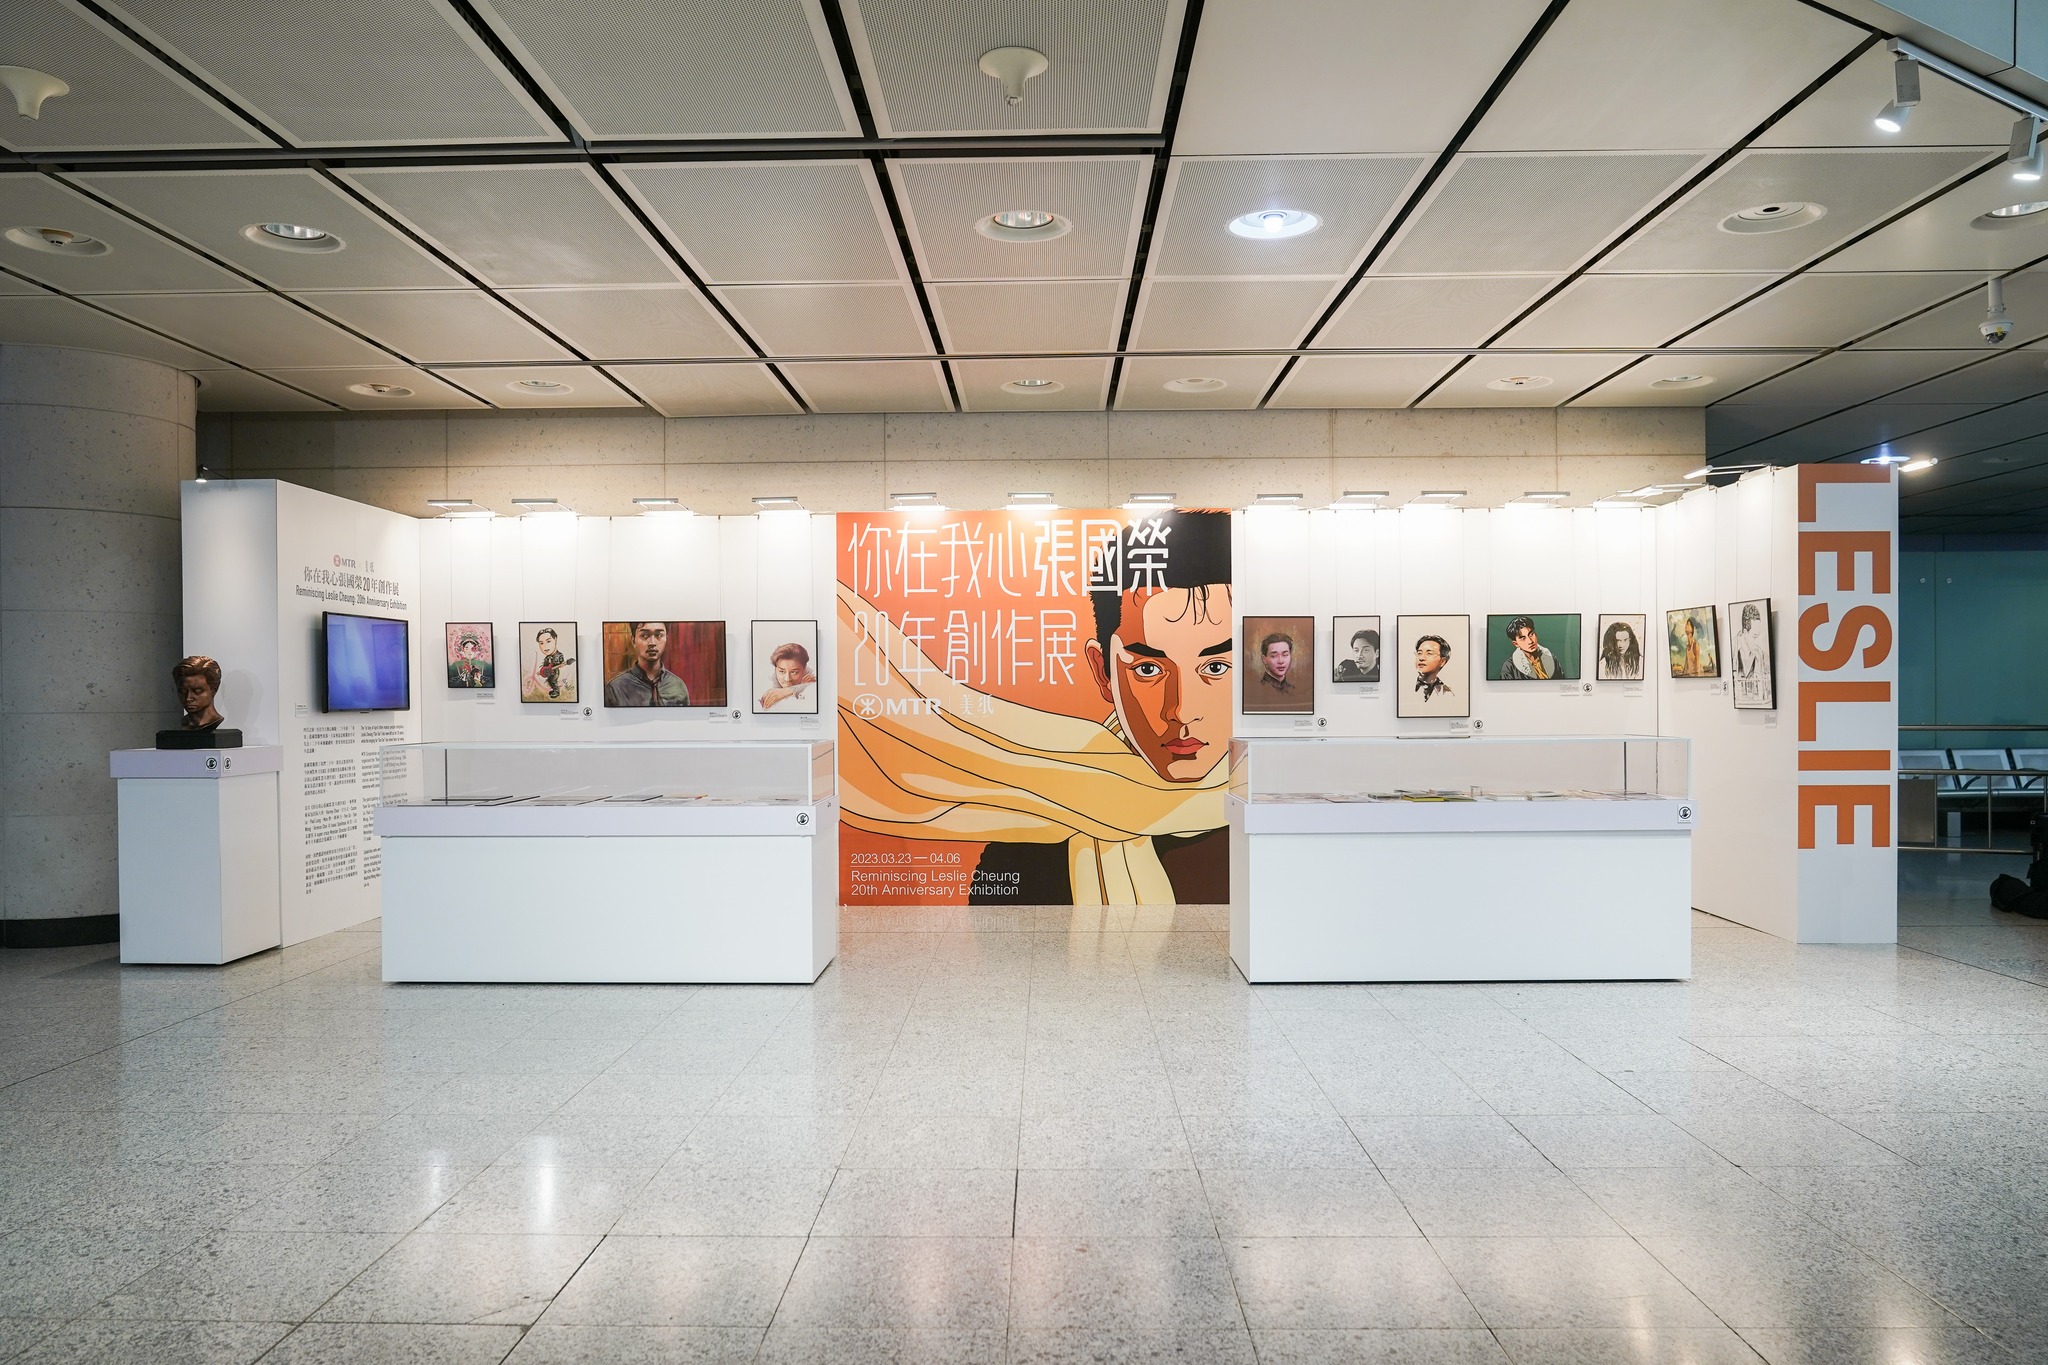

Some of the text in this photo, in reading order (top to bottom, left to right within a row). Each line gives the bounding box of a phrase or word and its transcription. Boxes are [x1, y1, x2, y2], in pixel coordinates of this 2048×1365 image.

[341, 558, 356, 568] MTR
[848, 518, 1172, 599] 你在我心張國榮
[296, 584, 325, 601] Reminiscing
[325, 589, 338, 601] Leslie
[366, 596, 389, 610] Anniversary
[389, 598, 408, 611] Exhibition
[853, 609, 1077, 687] 20年創作展
[1798, 463, 1893, 849] LESLIE
[886, 698, 943, 716] MTR
[851, 870, 1020, 885] Reminiscing Leslie Cheung
[851, 884, 1019, 899] 20th Anniversary Exhibition
